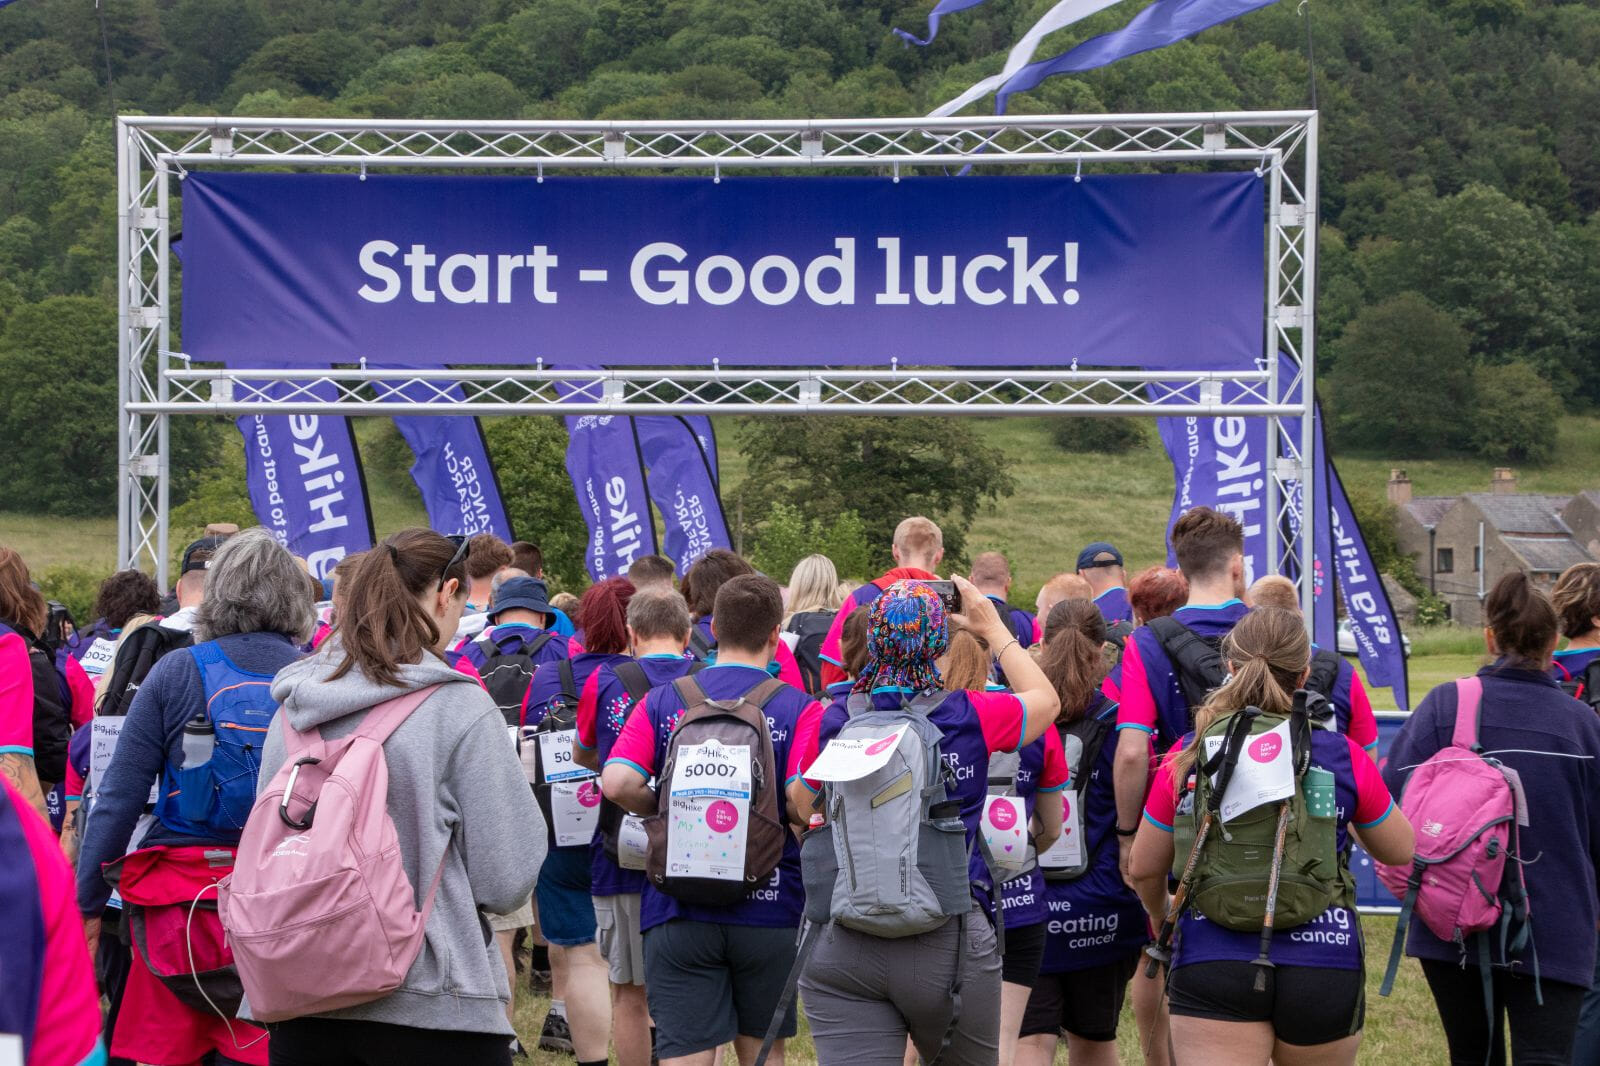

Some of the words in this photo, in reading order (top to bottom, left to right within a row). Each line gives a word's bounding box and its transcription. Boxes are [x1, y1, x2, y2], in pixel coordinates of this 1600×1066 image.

[357, 239, 558, 304] Start
[579, 269, 608, 282] -
[629, 237, 856, 306] Good
[875, 236, 1080, 306] luck!
[684, 763, 738, 778] 50007
[672, 800, 686, 808] Big
[685, 804, 703, 812] Hike
[1048, 900, 1072, 912] we
[1069, 933, 1118, 949] cancer
[1289, 930, 1351, 946] cancer
